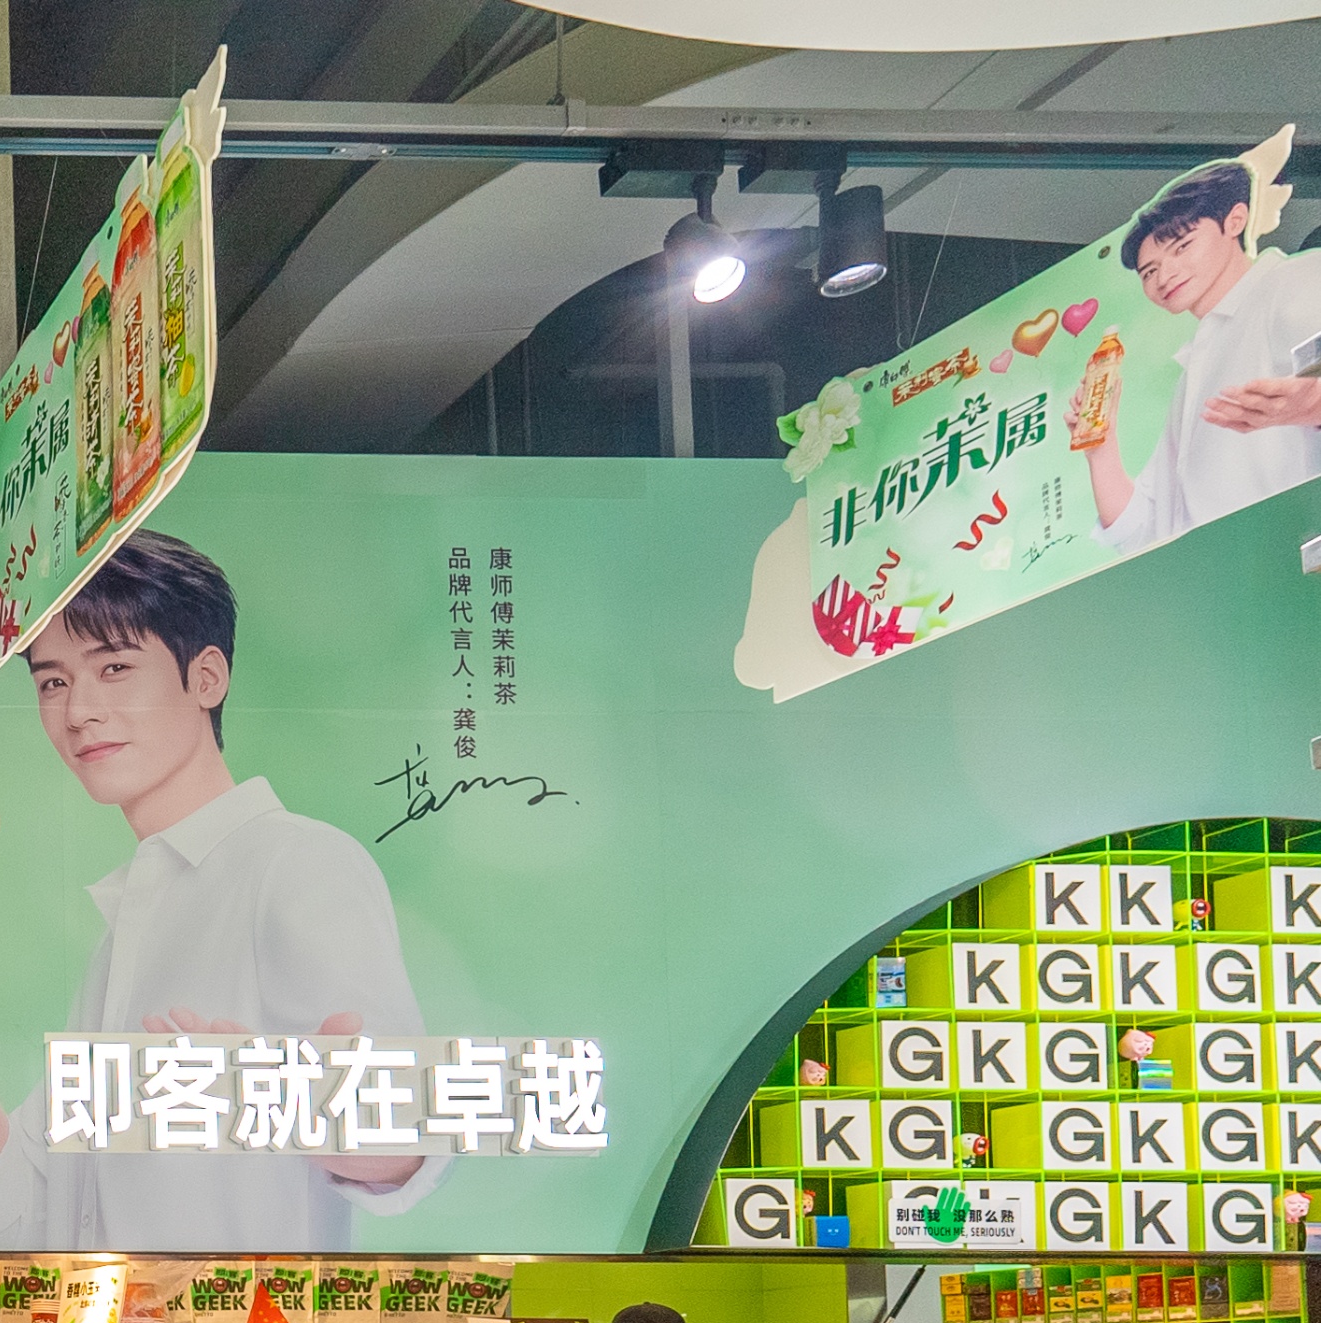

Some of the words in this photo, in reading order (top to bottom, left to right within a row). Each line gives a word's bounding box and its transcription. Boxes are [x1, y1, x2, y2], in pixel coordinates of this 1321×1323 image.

[819, 391, 1049, 549] 非你茉属
[448, 547, 478, 760] 品牌代言人：龚俊
[489, 546, 518, 706] 康师傅茉莉茶
[1045, 872, 1087, 926] K
[1119, 872, 1162, 926] K
[966, 950, 1010, 1004] K
[1037, 949, 1093, 1004] G
[1119, 951, 1164, 1005] K
[1204, 949, 1257, 1003] G
[889, 1027, 944, 1082] G
[972, 1028, 1017, 1082] K
[1045, 1028, 1100, 1083] G
[1199, 1029, 1254, 1083] G
[45, 1036, 610, 1152] 即客就在卓越
[815, 1107, 860, 1162] K
[888, 1105, 946, 1162] G
[1048, 1107, 1103, 1162] G
[1131, 1110, 1174, 1164] K
[1201, 1108, 1257, 1163] G
[734, 1184, 791, 1240] G
[1050, 1188, 1102, 1243] G
[1134, 1189, 1175, 1245] K
[1211, 1188, 1265, 1243] G
[895, 1226, 921, 1236] DON'T
[923, 1226, 951, 1236] TOUCH
[970, 1226, 1016, 1237] SERIOUSLY
[896, 1208, 941, 1223] 别碰我
[952, 1208, 1015, 1223] 没那么熟
[319, 1295, 373, 1312] GEEK
